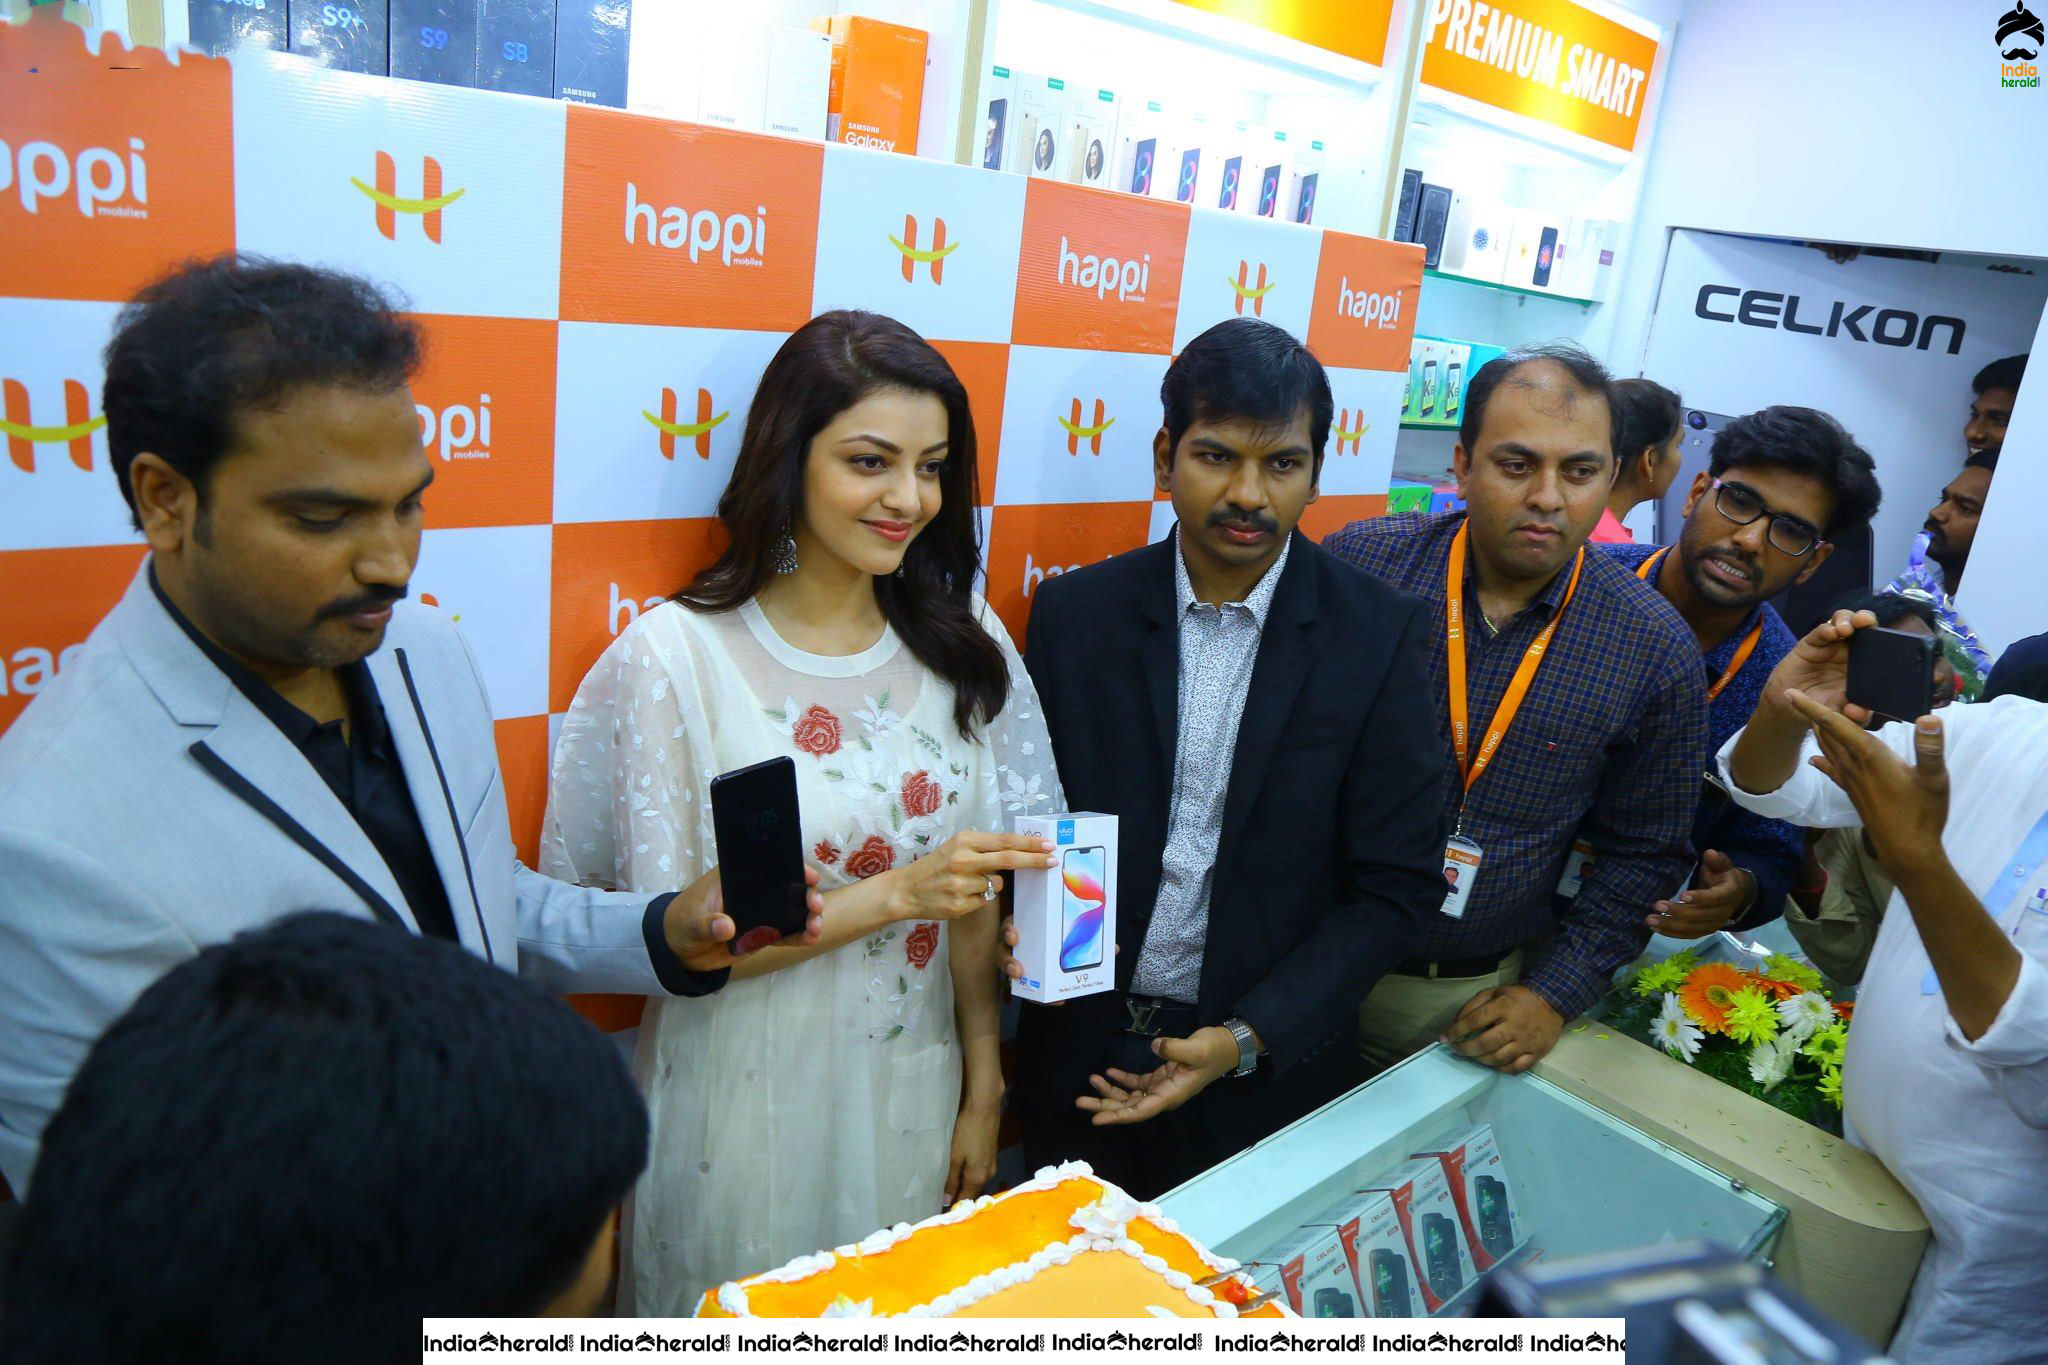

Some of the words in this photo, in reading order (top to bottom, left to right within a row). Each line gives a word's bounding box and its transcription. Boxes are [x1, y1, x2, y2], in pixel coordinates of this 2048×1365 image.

[420, 27, 449, 50] S9
[503, 41, 528, 63] S8
[1427, 0, 1563, 88] PREMIUM
[1561, 43, 1645, 117] SMART
[562, 87, 597, 99] SAMSUNG
[848, 122, 880, 133] SAMSUNG
[845, 131, 896, 152] Galaxy
[0, 136, 148, 218] ppi
[97, 205, 148, 219] mobiles
[625, 181, 767, 267] happi
[733, 257, 763, 267] mobiles
[1058, 235, 1151, 302] happi
[1337, 275, 1402, 330] happi
[1695, 284, 1967, 355] CELKON
[453, 450, 490, 460] mobiles
[1075, 973, 1089, 984] V9
